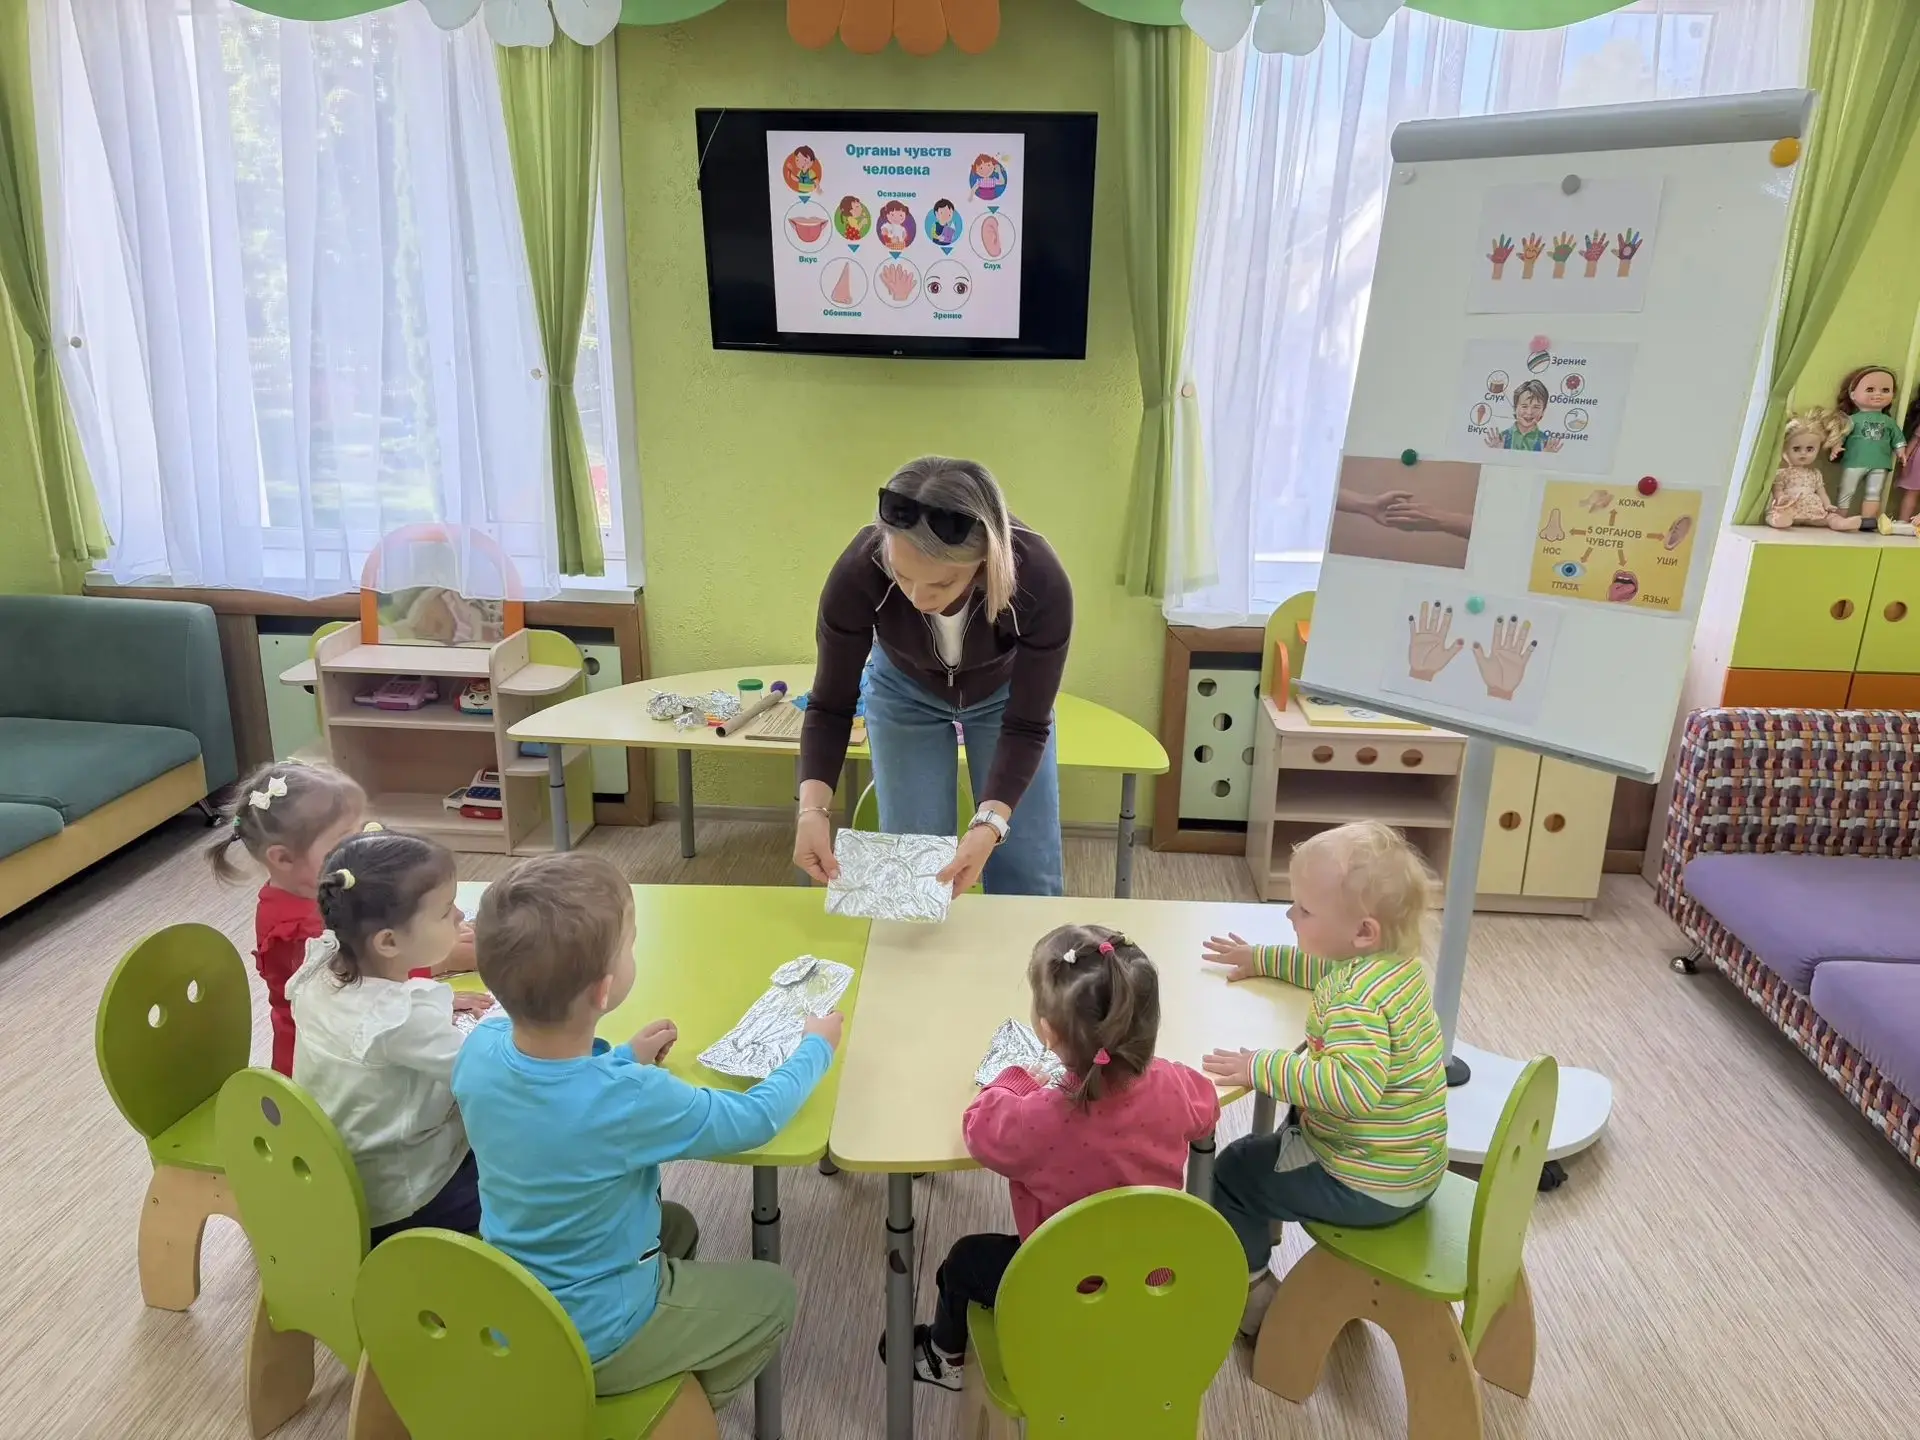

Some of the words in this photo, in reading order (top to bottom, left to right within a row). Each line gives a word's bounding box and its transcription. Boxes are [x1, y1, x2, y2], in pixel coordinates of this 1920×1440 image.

[846, 143, 900, 157] Органы
[904, 145, 951, 158] чувств
[862, 164, 930, 177] человека
[799, 256, 818, 264] Вкус
[983, 262, 1002, 271] Слух
[933, 311, 962, 320] Зрение
[1551, 356, 1587, 367] Зрение
[1484, 392, 1505, 402] Слух
[1549, 395, 1598, 406] Обоняние
[1467, 424, 1488, 435] Вкус
[1618, 499, 1645, 509] КОЖА
[1587, 526, 1593, 534] 5
[1595, 526, 1642, 539] ОРГАНОВ
[1586, 537, 1624, 548] ЧУВСТВ
[1542, 546, 1562, 555] НОС
[1656, 556, 1678, 566] УШИ
[1551, 580, 1580, 592] ГЛАЗА
[1642, 594, 1670, 605] ЯЗЫК
